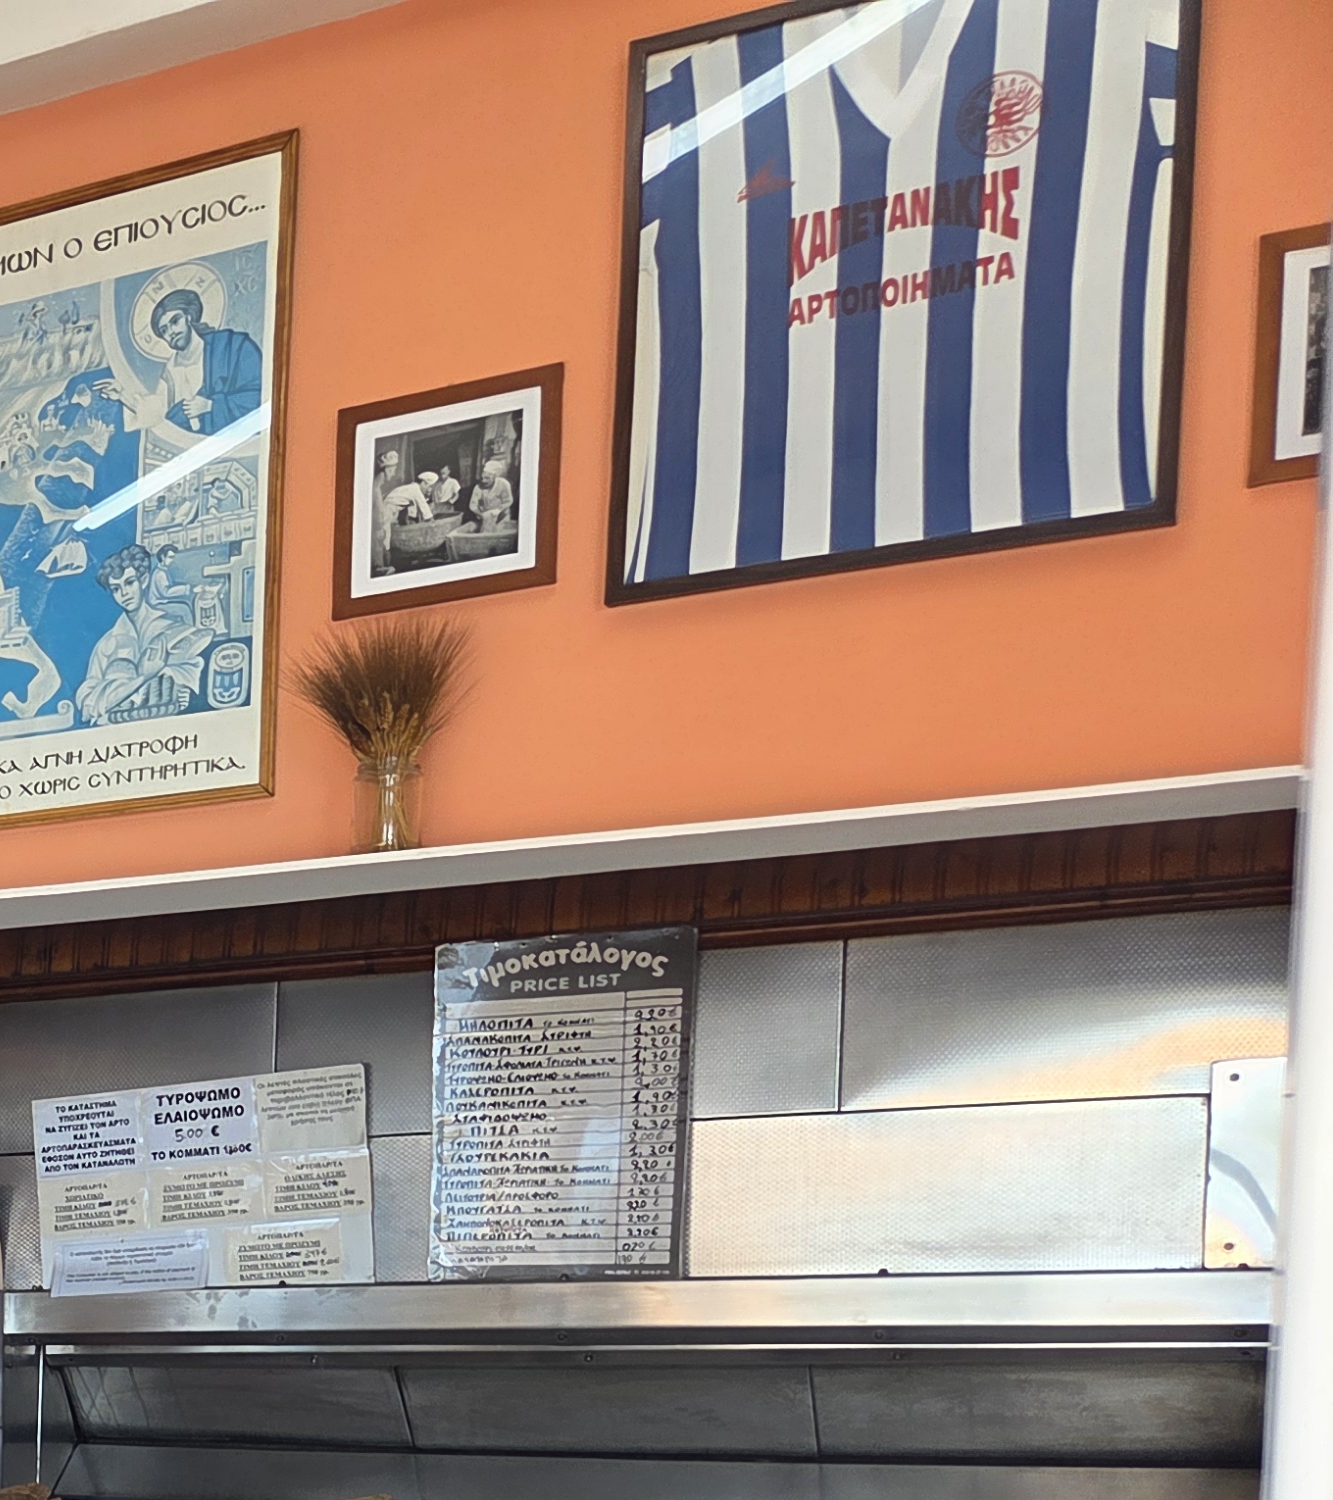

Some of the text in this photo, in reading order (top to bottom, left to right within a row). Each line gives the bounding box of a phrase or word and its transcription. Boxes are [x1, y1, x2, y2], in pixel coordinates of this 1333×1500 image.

[786, 164, 1020, 289] ΚΑΠΕΤΑΝΑΚΗΣ
[788, 251, 1015, 330] ΑΡΤΟΠΟΙΗΜΑΤΑ
[463, 941, 669, 988] Τιμοκατάλογος
[510, 973, 621, 993] PRICE LIST
[156, 1087, 241, 1107] ΤΥΡΟΨΩΜΟ
[55, 1100, 118, 1114] ΤΟ ΚΑΤΑΣΤΗΜΑ
[154, 1104, 245, 1125] ΕΛΑΙΟΨΩΜΟ
[59, 1110, 114, 1123] ΥΠΟΧΡΕΟΥΤΑΙ
[45, 1125, 56, 1133] ΝΑ
[90, 1120, 107, 1129] ΤΟΝ
[108, 1117, 130, 1127] ΑΡΤΟ
[73, 1131, 101, 1141] ΚΑΙ ΤΑ
[41, 1137, 136, 1153] ΑΡΤΟΠΑΡΑΣΚΕΥΑΣΜΑΤΑ
[42, 1147, 135, 1163] ΕΦΟΣΟΝ ΑΥΤΟ ΖΗΤΗΘΕΙ
[151, 1151, 166, 1161] ΤΟ
[169, 1146, 220, 1160] ΚΟΜΜΑΤΙ
[44, 1164, 61, 1173] ΑΠΟ
[63, 1162, 80, 1171] ΤΟΝ
